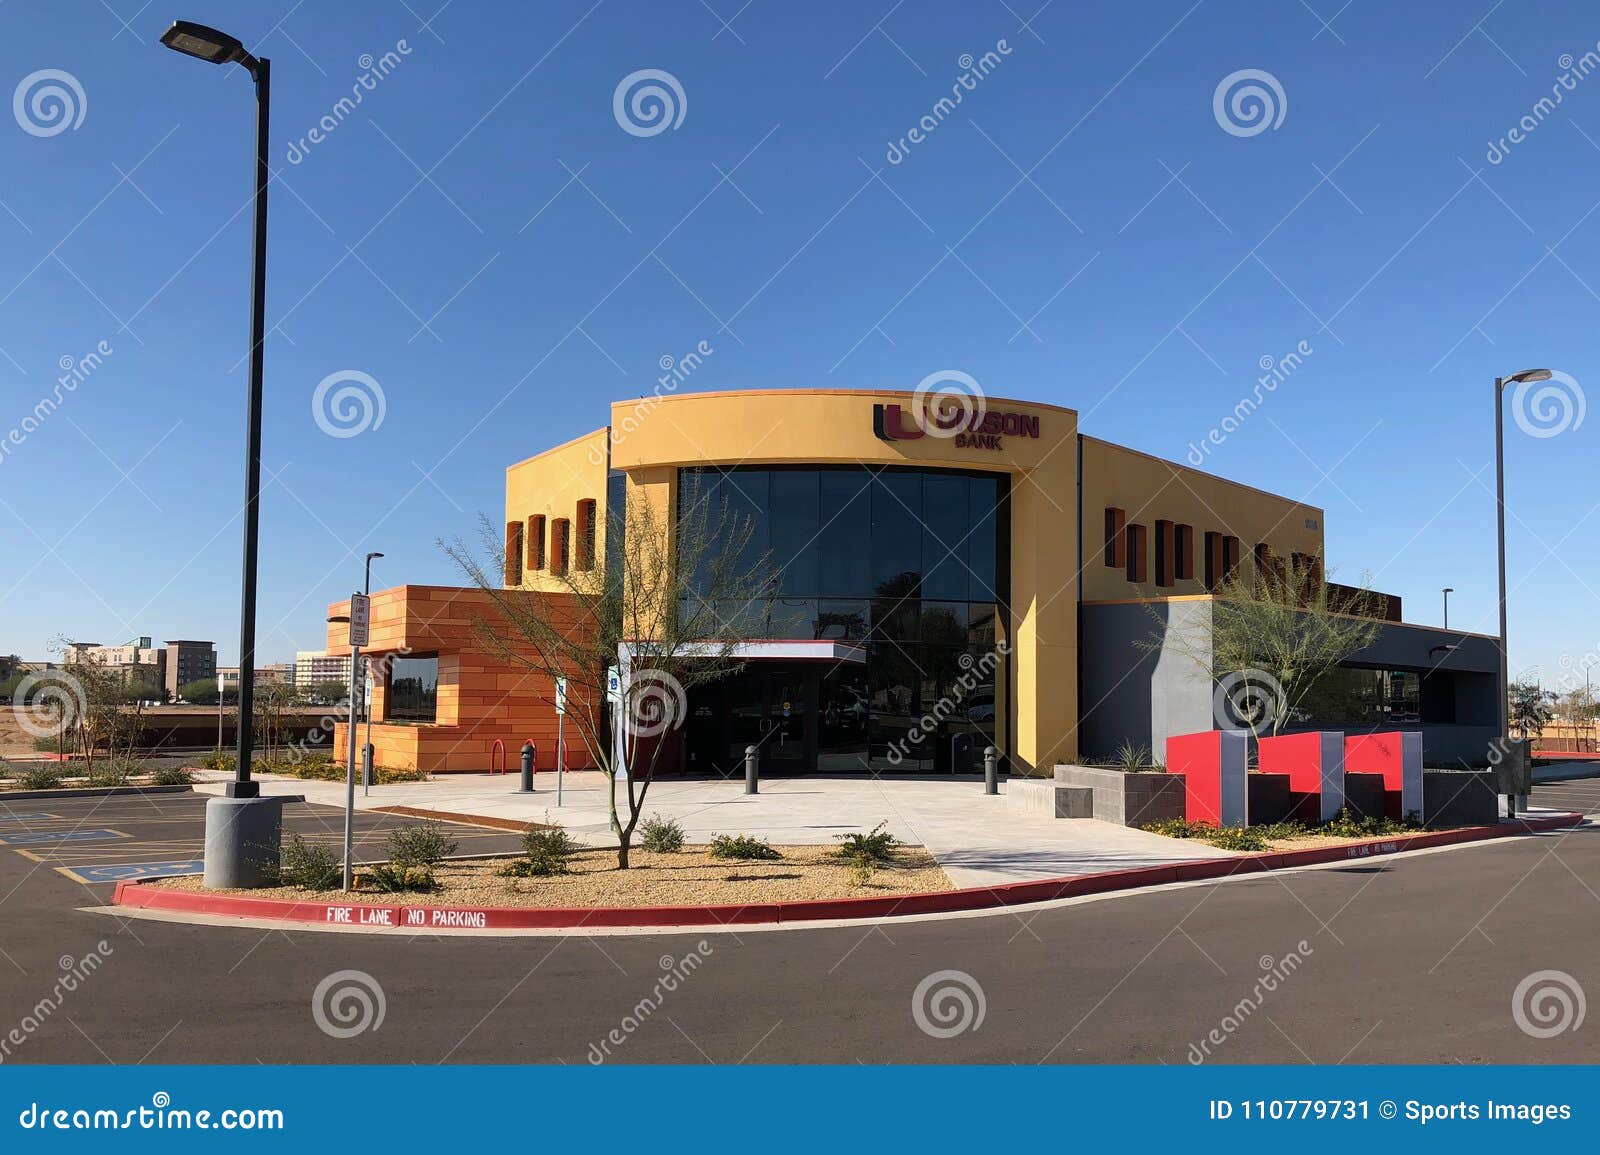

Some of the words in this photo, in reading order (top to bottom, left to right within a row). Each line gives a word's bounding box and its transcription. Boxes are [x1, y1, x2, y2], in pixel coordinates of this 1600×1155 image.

[954, 433, 1004, 451] BANK
[327, 907, 353, 923] FIRE
[360, 908, 393, 925] LANE
[407, 909, 425, 925] NO
[432, 910, 486, 928] PARKING
